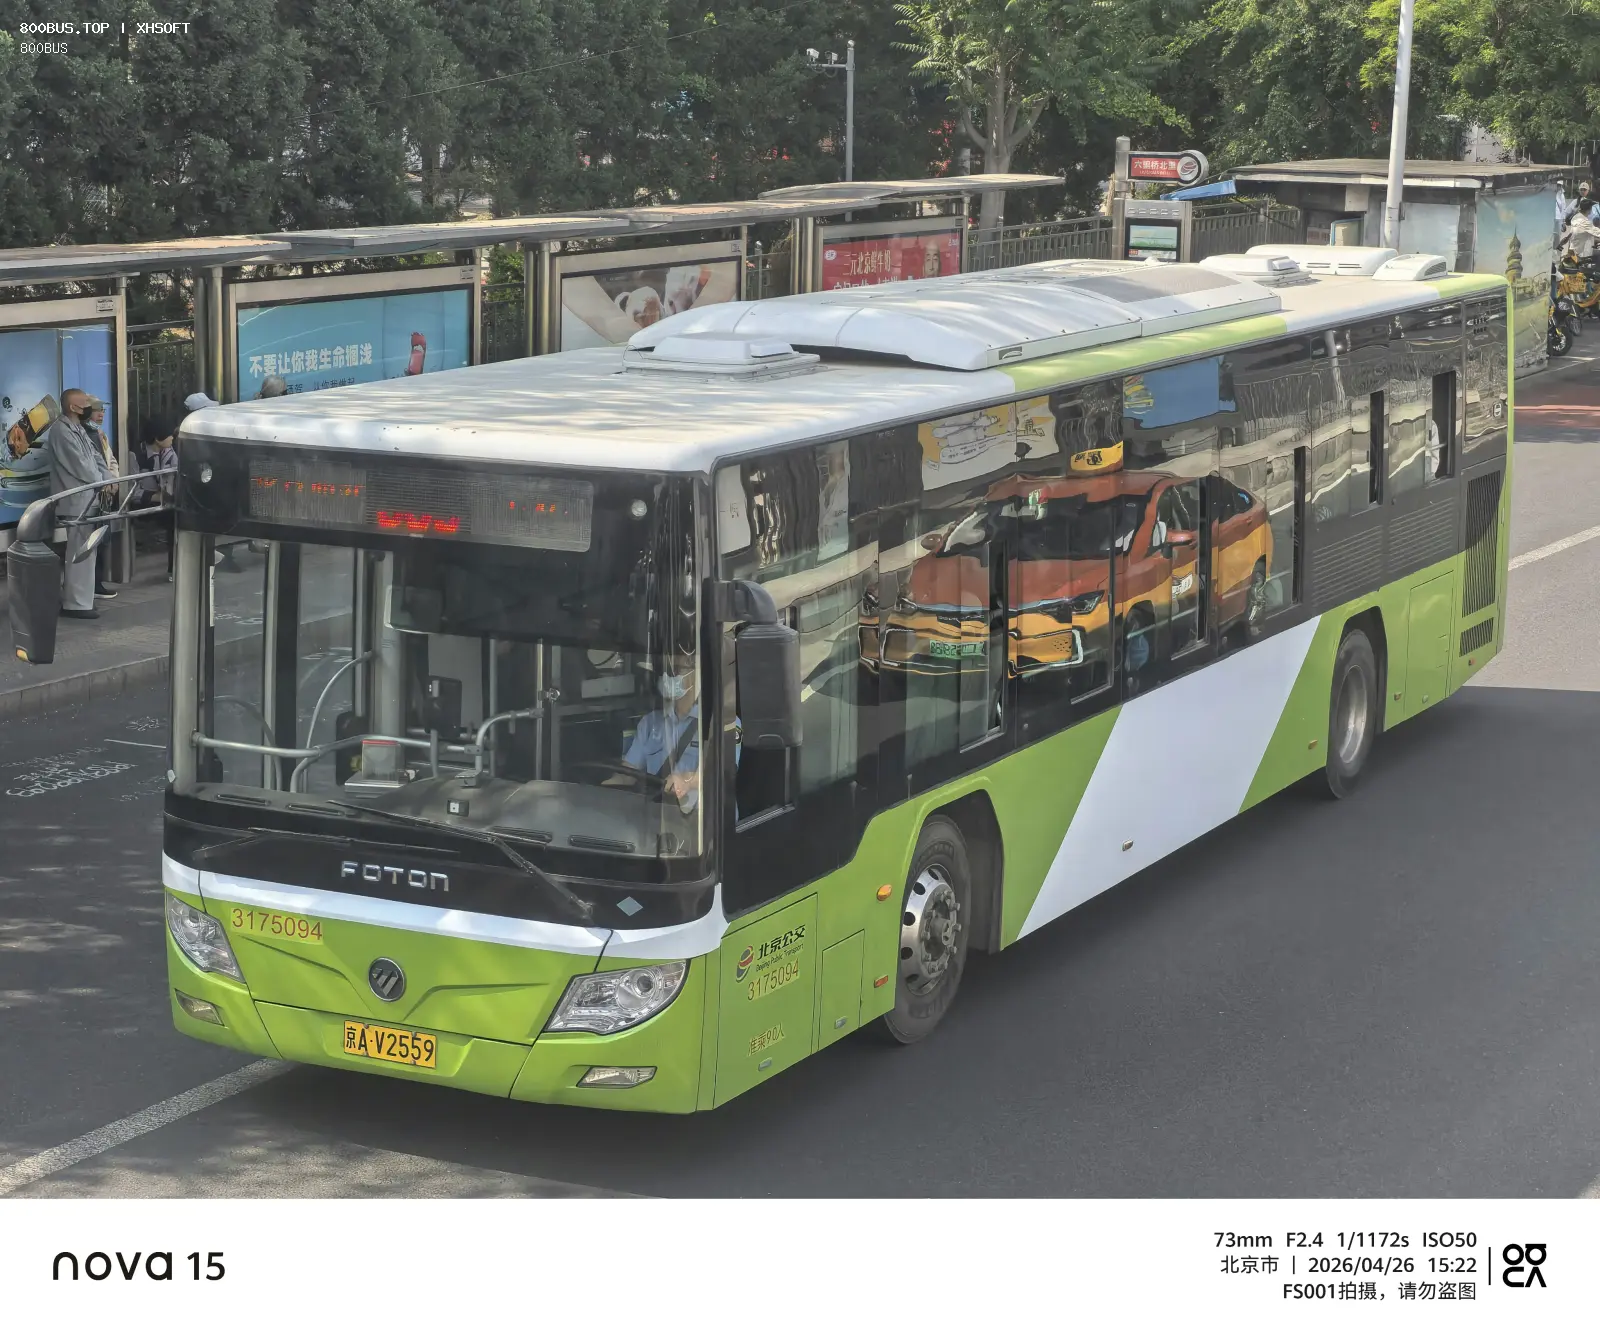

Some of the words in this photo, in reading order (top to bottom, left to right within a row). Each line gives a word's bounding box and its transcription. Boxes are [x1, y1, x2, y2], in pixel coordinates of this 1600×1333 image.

[843, 249, 891, 277] 三元北京鲜牛奶
[249, 342, 373, 379] 不要让你我生命搁浅
[340, 860, 449, 892] FOTON
[231, 907, 323, 940] 3175094
[757, 924, 806, 961] 北京公交
[747, 957, 800, 1001] 3175094
